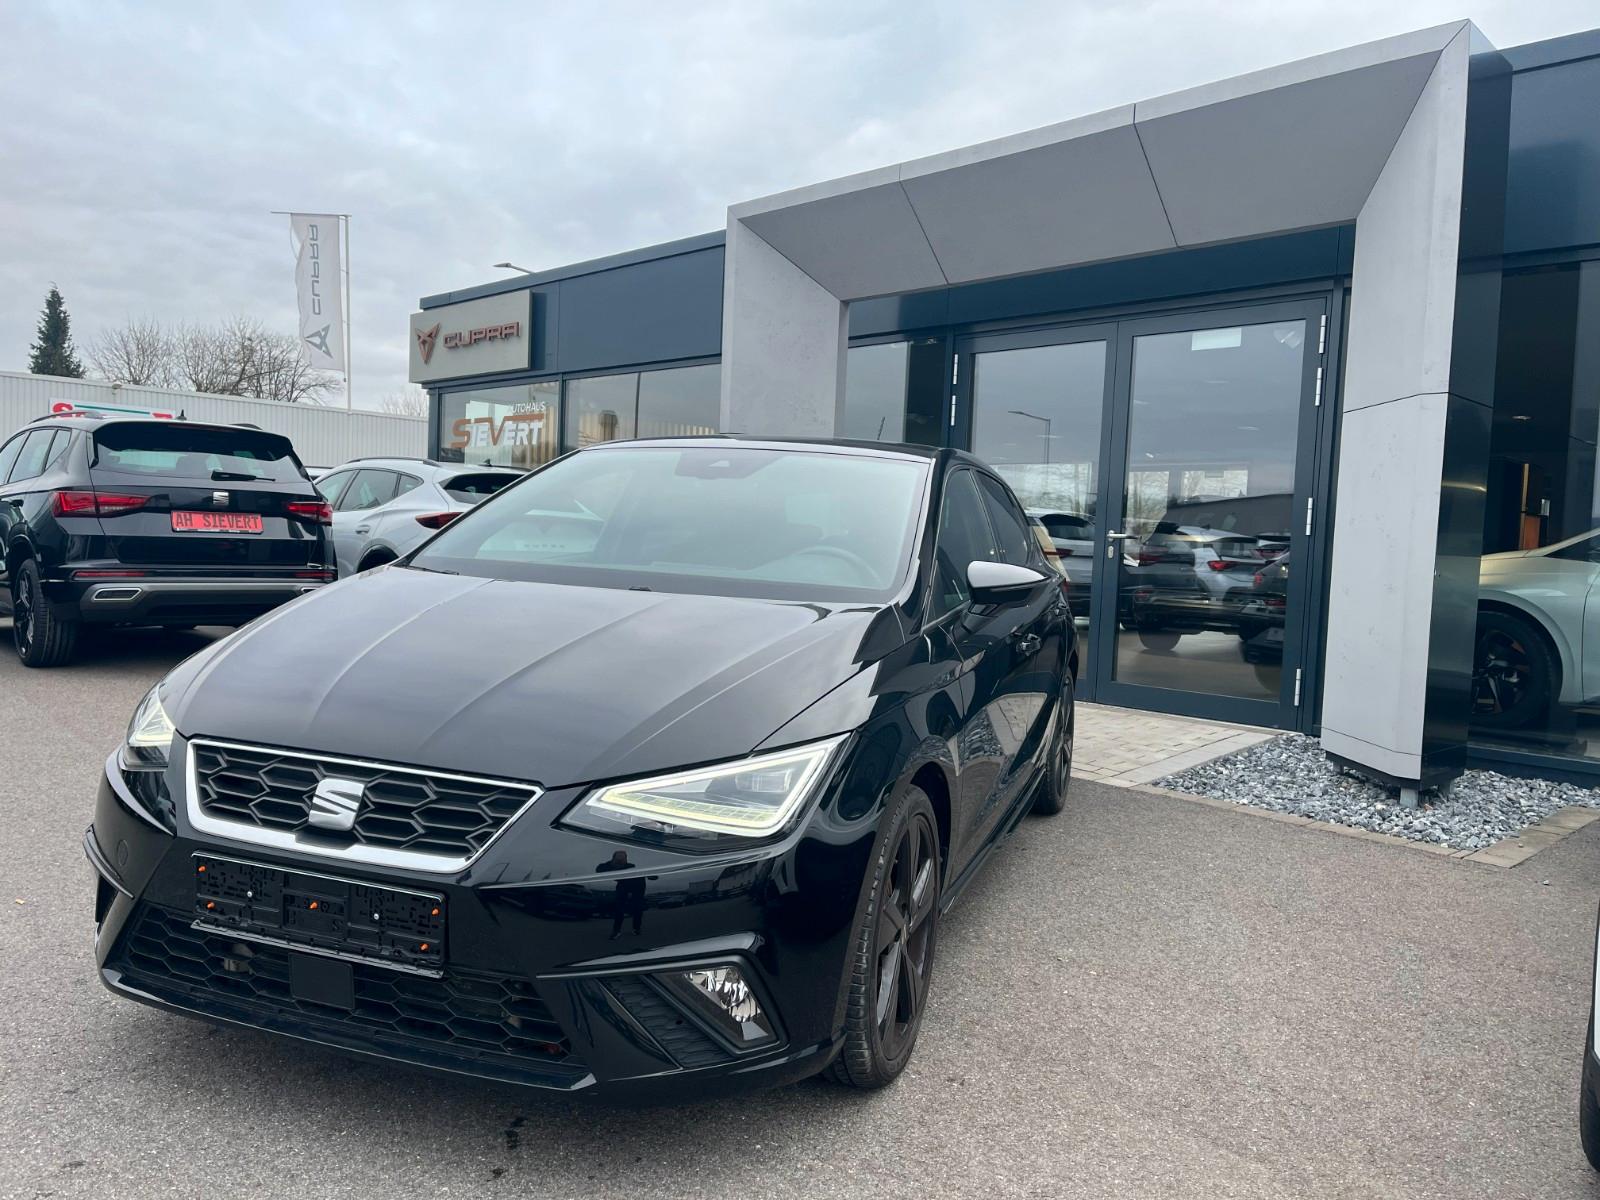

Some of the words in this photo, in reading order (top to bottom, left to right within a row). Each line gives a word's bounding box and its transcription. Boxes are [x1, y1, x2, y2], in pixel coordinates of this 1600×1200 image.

[443, 321, 520, 349] CUPRA
[507, 401, 546, 413] UTOHAUS
[452, 413, 544, 448] SIEVERT
[176, 513, 193, 527] AH
[203, 513, 259, 529] SIEVERT
